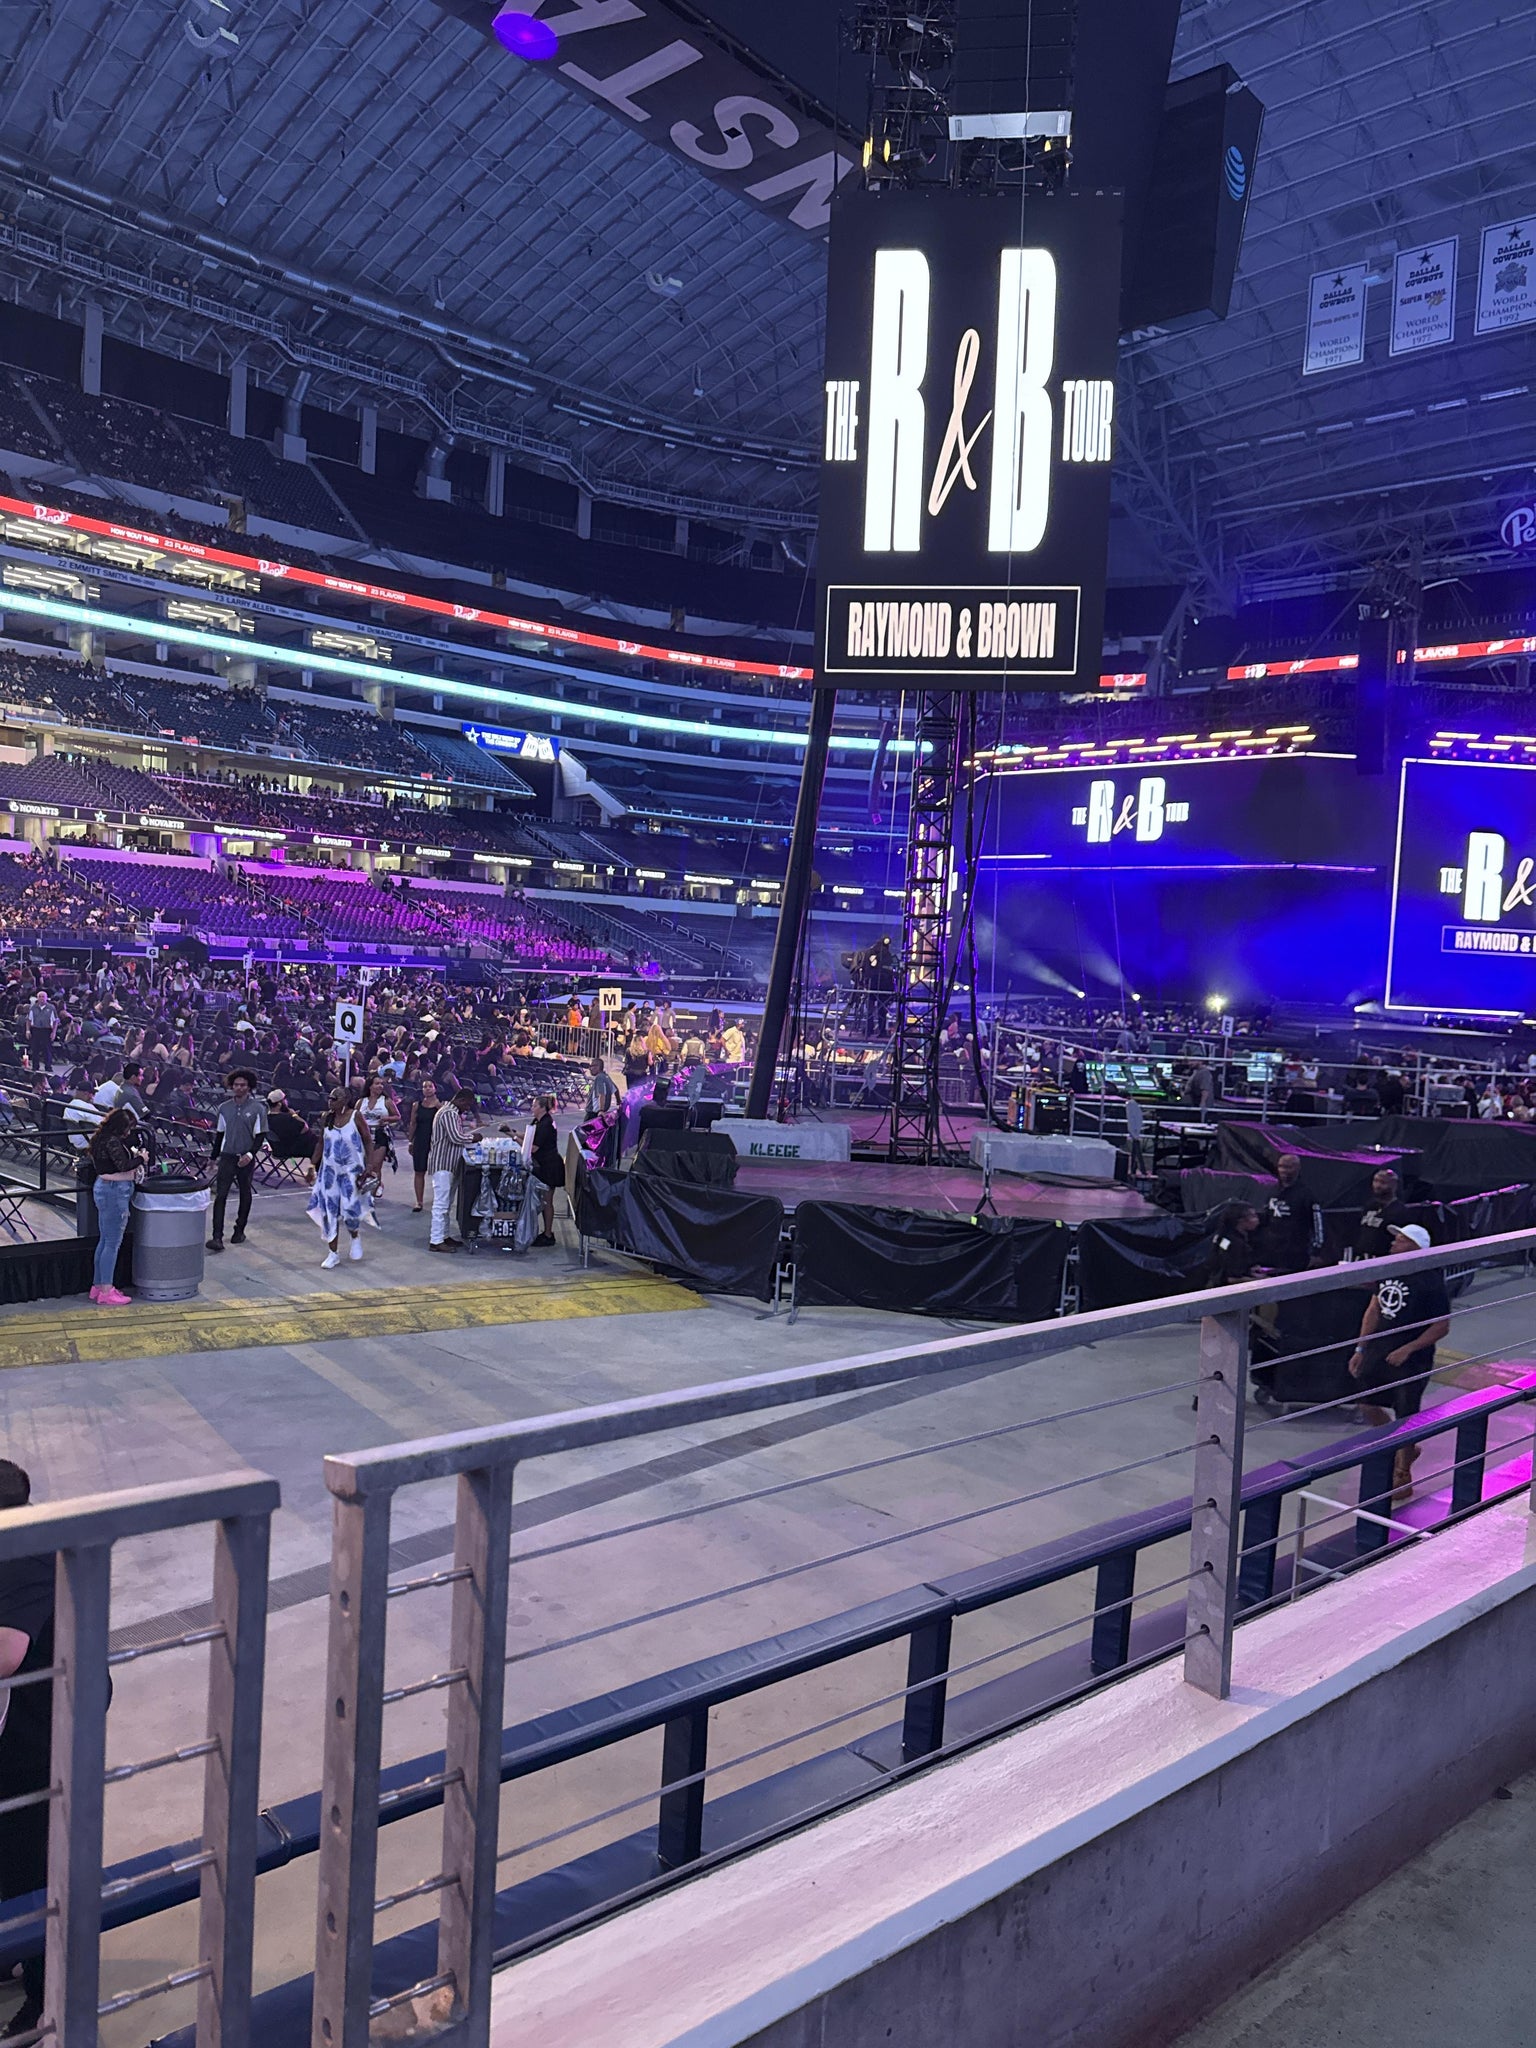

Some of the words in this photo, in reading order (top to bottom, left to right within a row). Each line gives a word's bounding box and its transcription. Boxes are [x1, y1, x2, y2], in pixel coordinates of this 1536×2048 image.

[1497, 240, 1531, 255] DALLAS
[1492, 248, 1534, 264] COWBOYS
[1409, 264, 1440, 279] DALLAS
[1405, 272, 1444, 288] COWBOYS
[1319, 294, 1356, 309] COWBOYS
[1323, 287, 1353, 301] DALLAS
[1493, 293, 1527, 306] WORLD
[1406, 314, 1439, 328] WORLD
[1500, 313, 1519, 324] 1992
[1396, 321, 1448, 340] CHAMPIONS
[1320, 336, 1350, 348] WORLD
[1310, 344, 1358, 359] CHAMPIONS
[825, 380, 860, 462] THE
[1062, 379, 1114, 462] TOUR
[174, 542, 205, 555] FLAVORS
[69, 562, 101, 574] EMMITT
[102, 569, 128, 581] SMITH
[226, 597, 251, 607] LARRY
[252, 602, 276, 613] ALLEN
[847, 602, 952, 657] RAYMOND
[956, 608, 973, 658] &
[976, 602, 1056, 658] BROWN
[19, 804, 59, 816] NOVARTIS
[149, 818, 185, 830] NOVARTIS
[320, 837, 352, 848] NOVARTIS
[1440, 867, 1464, 894] THE
[1454, 931, 1519, 952] RAYMOND
[1519, 936, 1531, 952] &
[603, 994, 616, 1006] M
[340, 1010, 357, 1035] Q
[1225, 1021, 1231, 1032] E
[750, 1142, 801, 1158] KLEEGE
